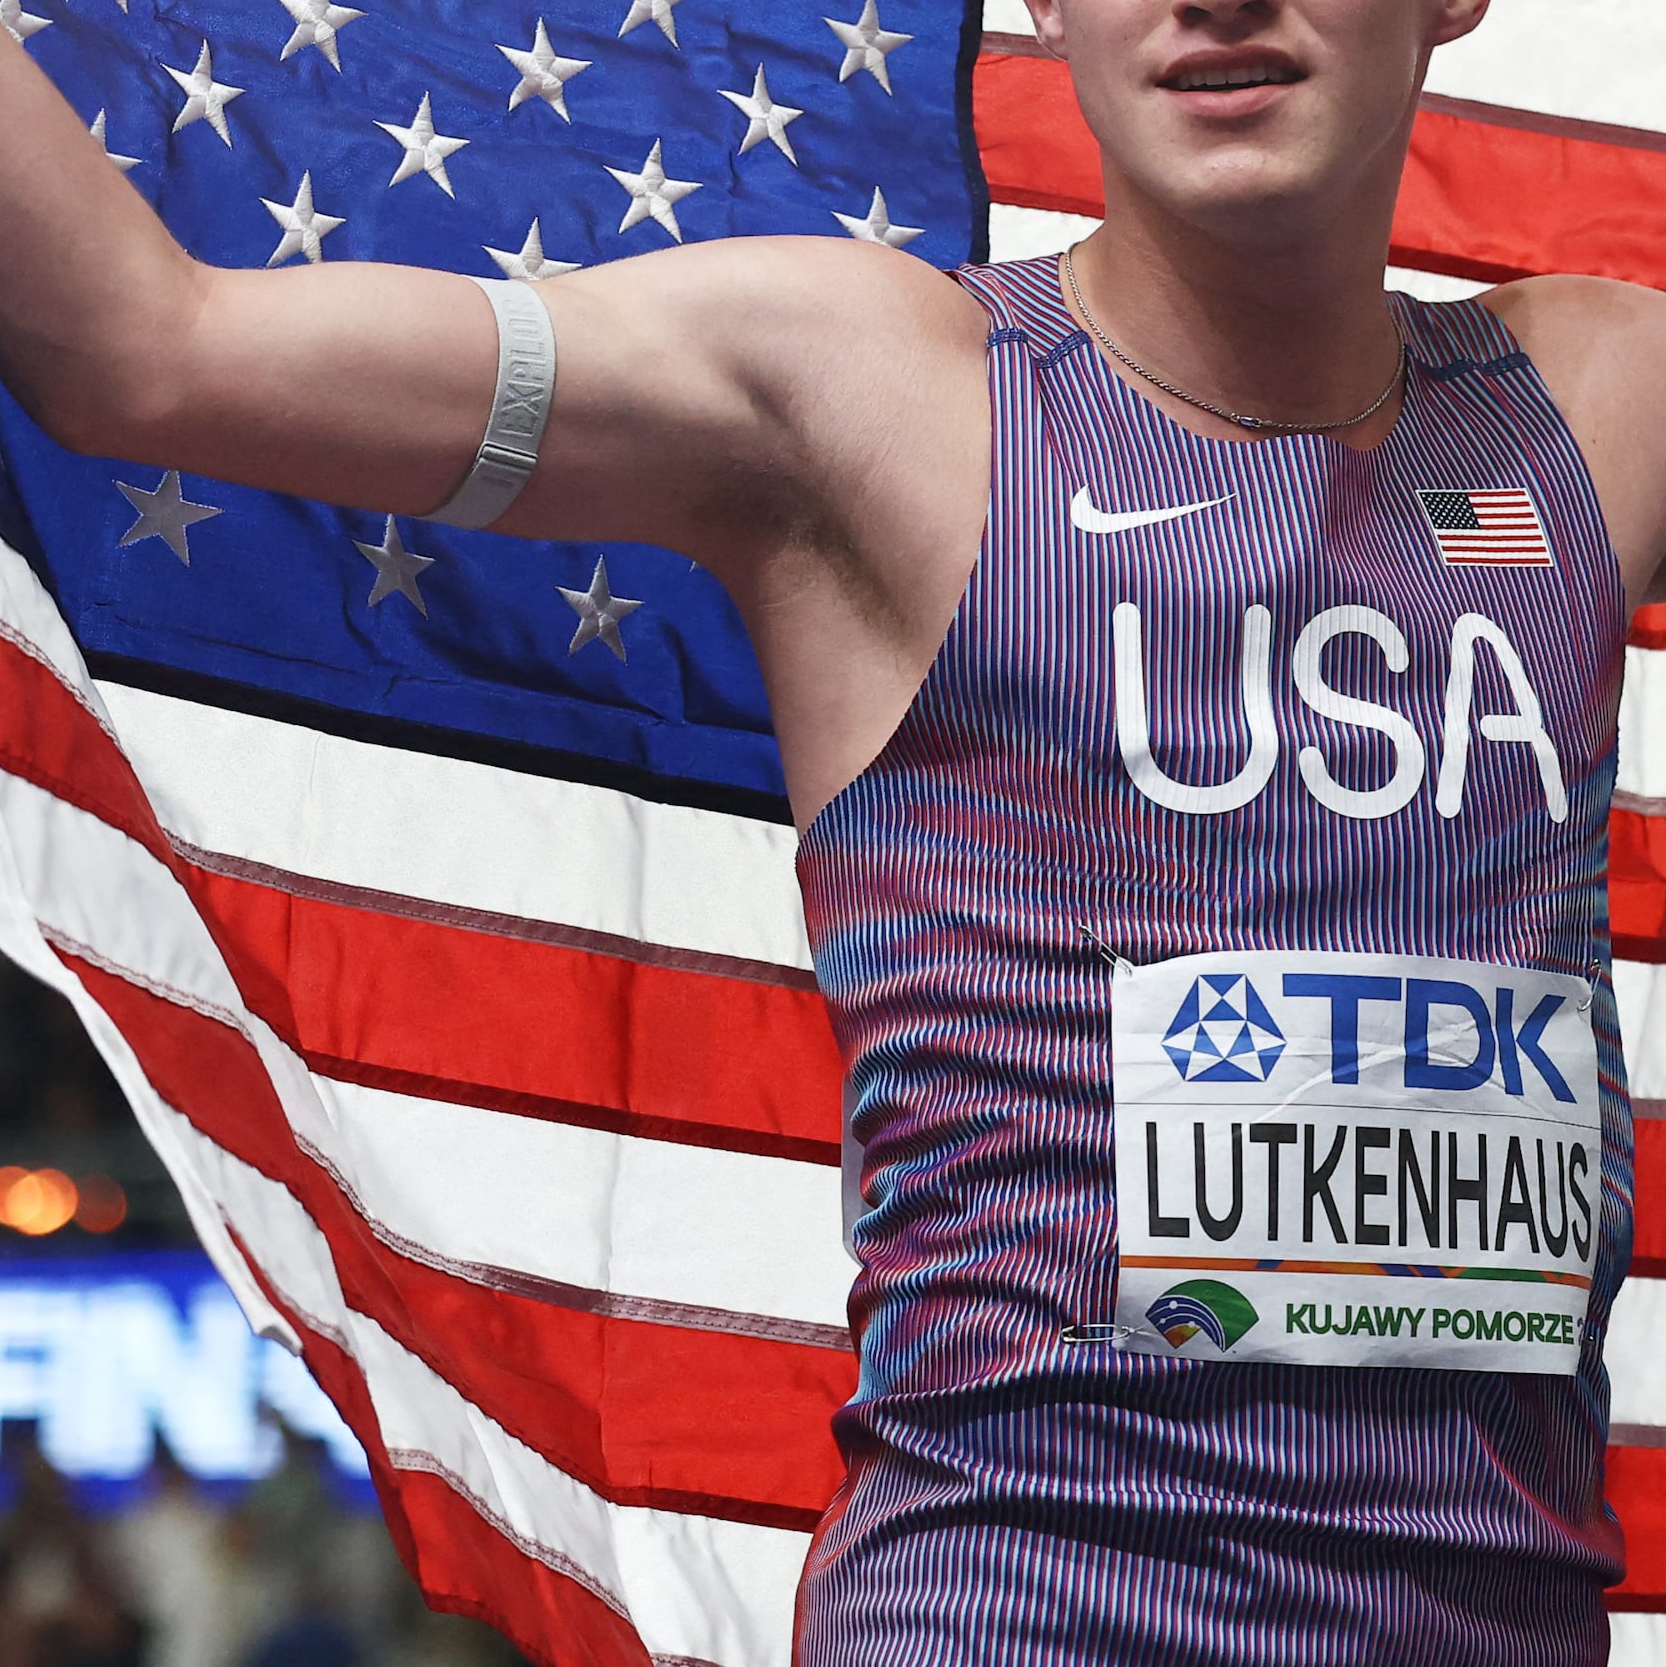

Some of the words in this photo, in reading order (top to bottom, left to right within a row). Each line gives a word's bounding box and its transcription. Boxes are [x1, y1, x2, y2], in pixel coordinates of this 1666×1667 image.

[1112, 601, 1568, 824] USA
[1282, 972, 1577, 1105] TDK
[1145, 1121, 1592, 1263] LUTKENHAUS
[1285, 1303, 1426, 1339] KUJAWY
[1432, 1309, 1575, 1346] POMORZE
